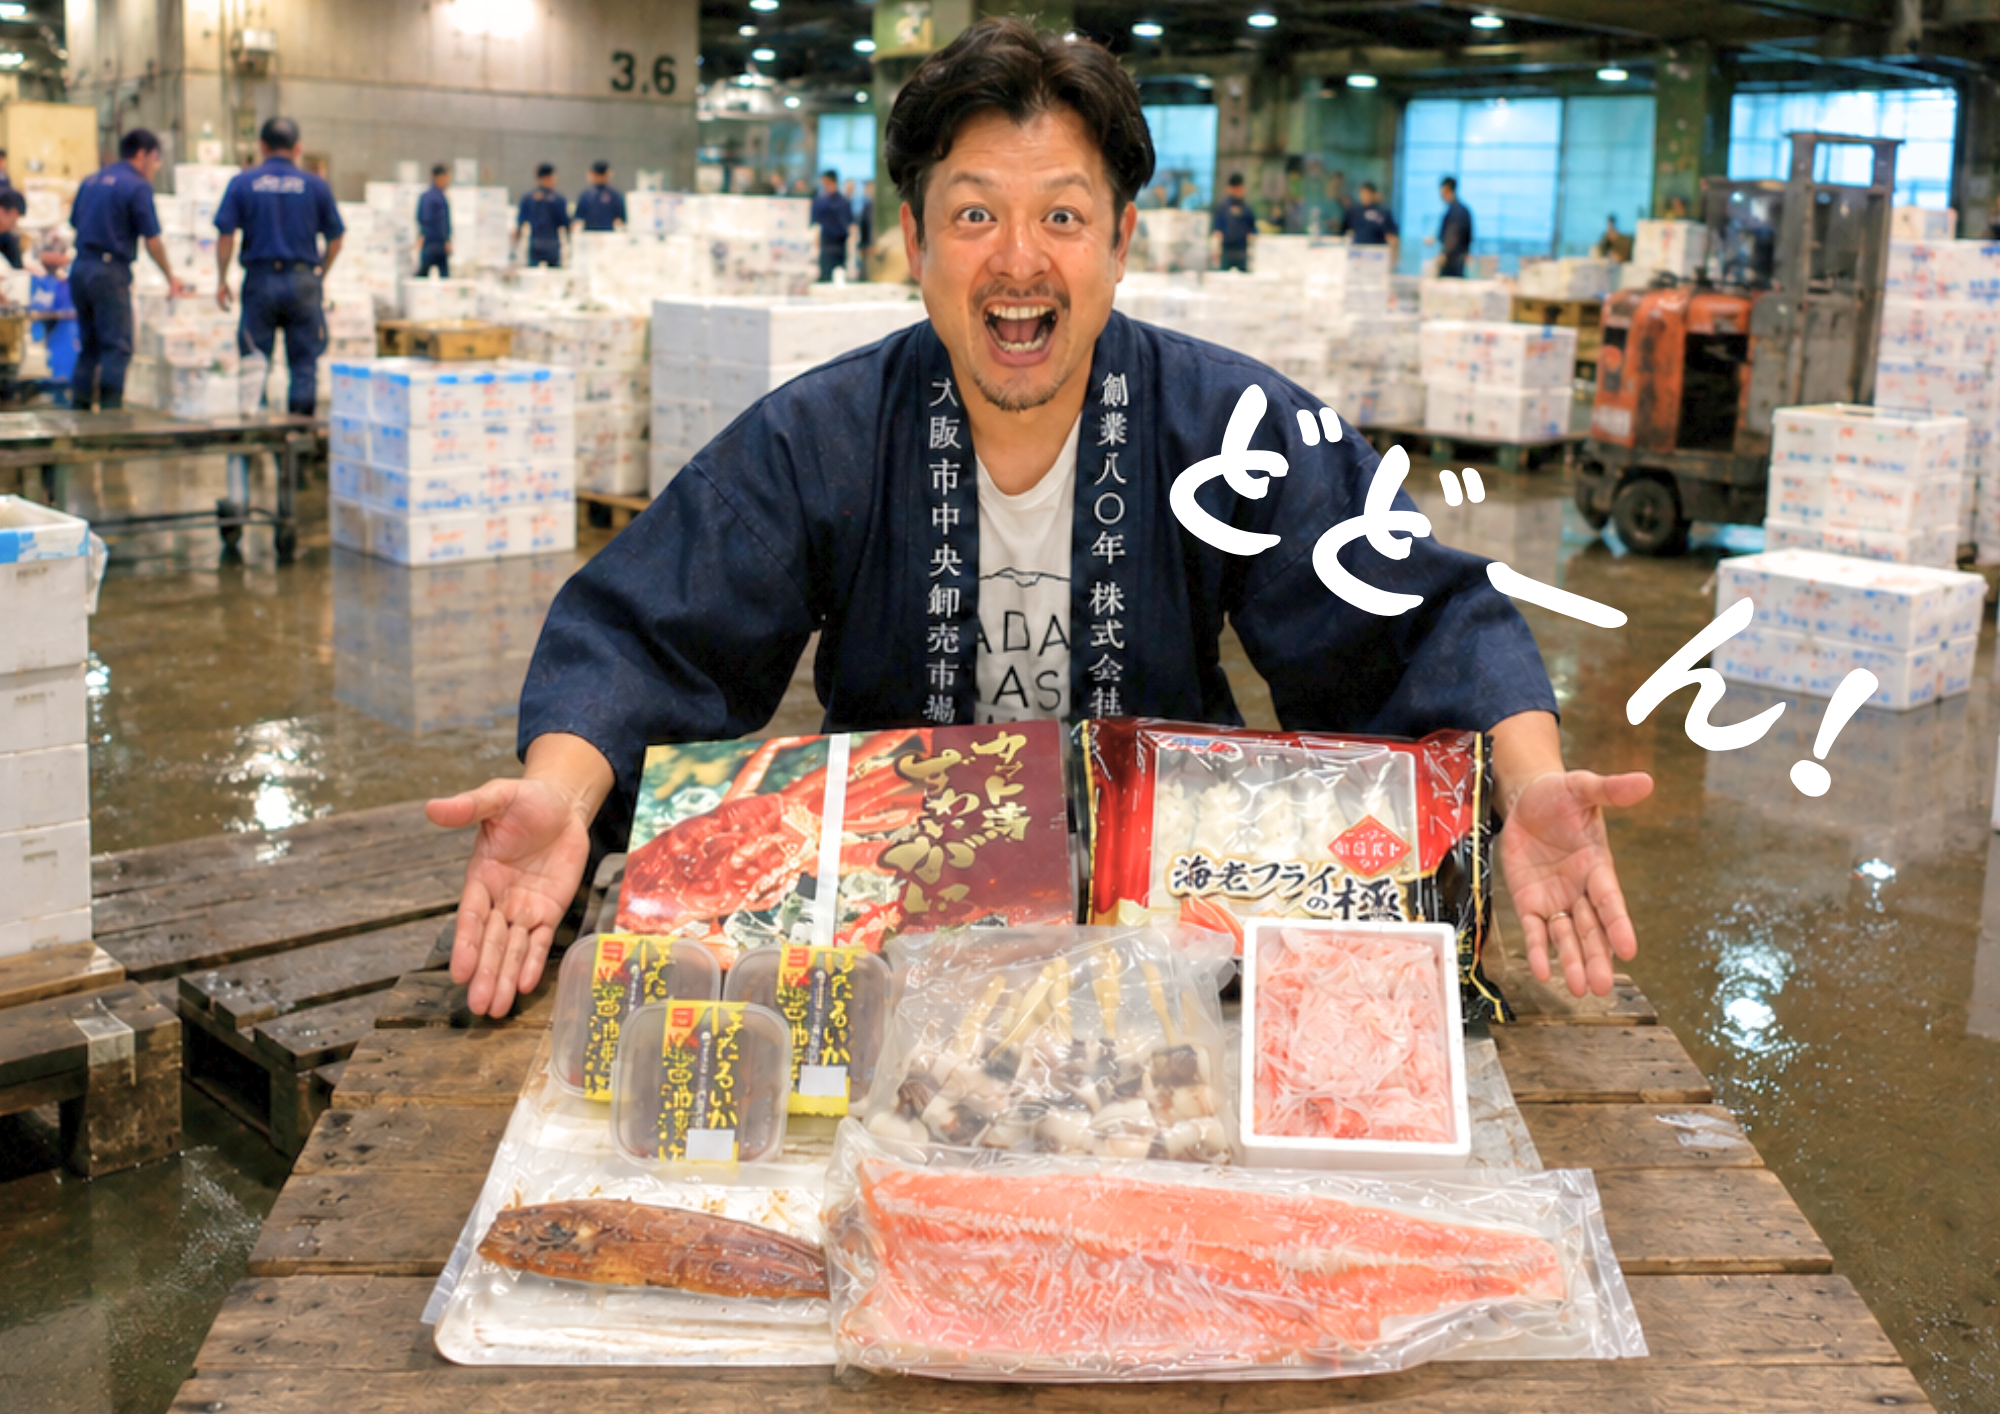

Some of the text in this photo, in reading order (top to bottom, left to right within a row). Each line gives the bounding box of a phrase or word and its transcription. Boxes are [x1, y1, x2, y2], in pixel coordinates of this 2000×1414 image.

[610, 50, 678, 95] 3.6
[1089, 581, 1126, 718] 株式会社
